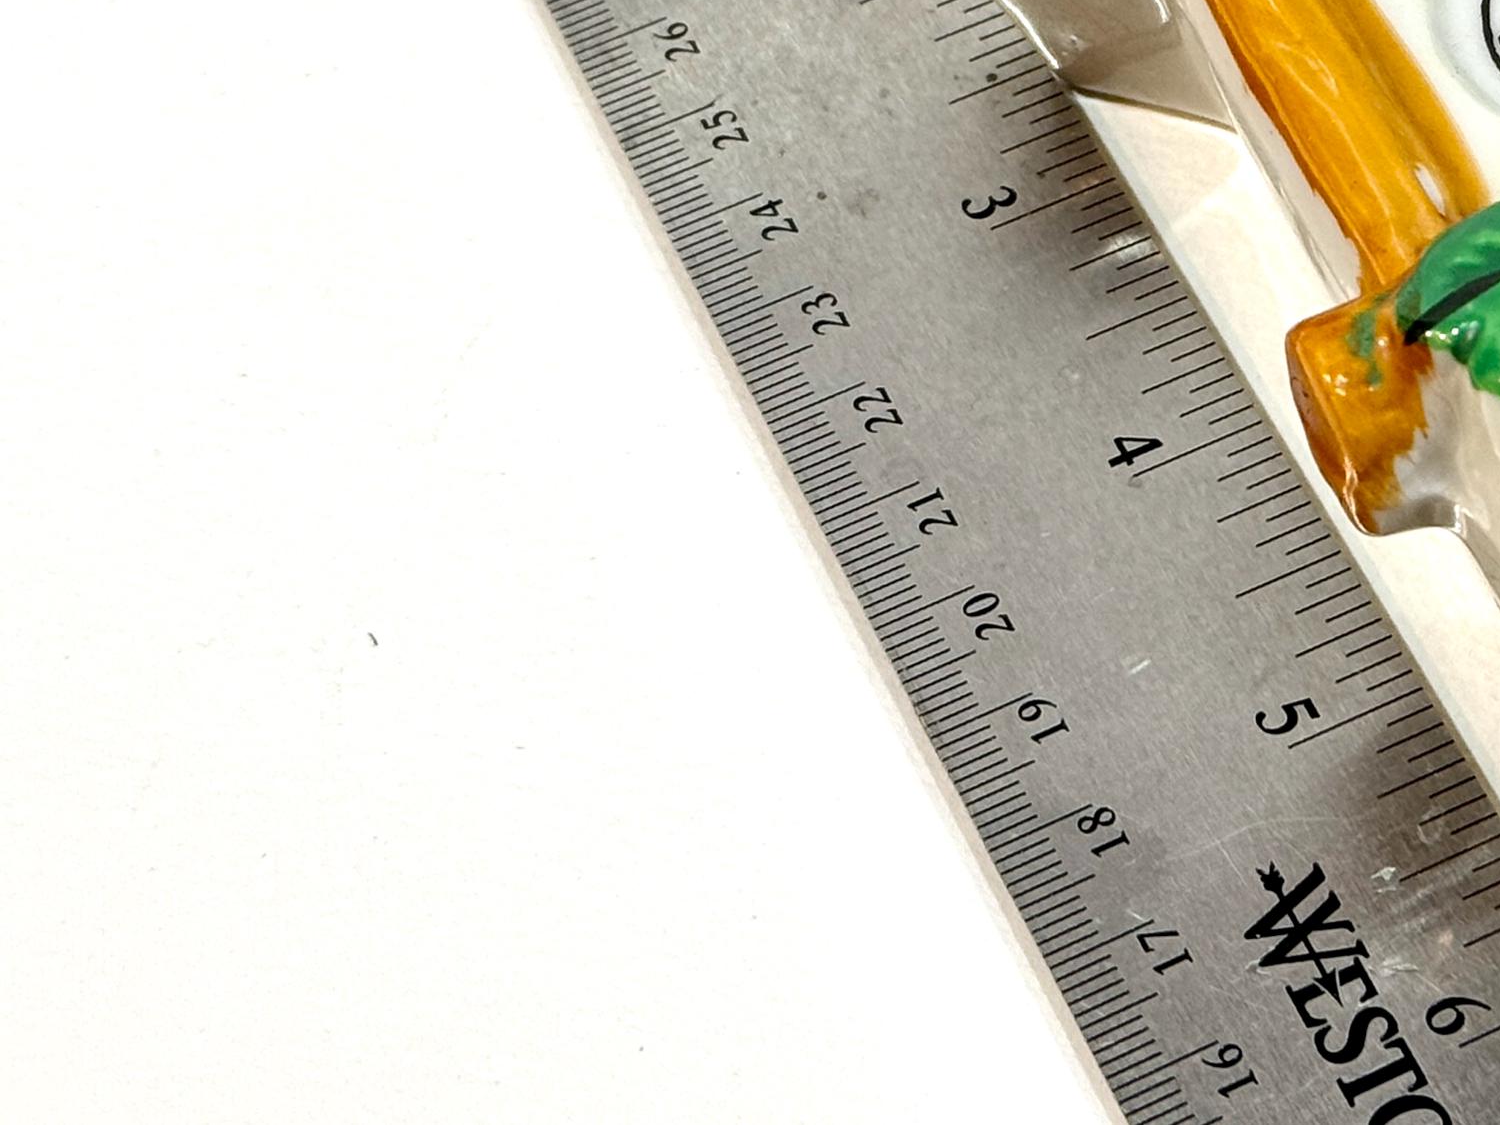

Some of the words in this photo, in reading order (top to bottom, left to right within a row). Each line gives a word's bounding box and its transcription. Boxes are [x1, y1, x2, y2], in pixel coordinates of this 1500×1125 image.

[652, 21, 700, 63] 26
[700, 110, 750, 150] 25
[748, 198, 799, 242] 24
[961, 186, 1018, 220] 3
[801, 292, 850, 336] 23
[852, 387, 904, 434] 22
[1107, 435, 1164, 468] 4
[907, 487, 959, 535] 21
[962, 592, 1016, 641] 20
[1017, 697, 1070, 745] 19
[1254, 697, 1320, 735] 5
[1077, 806, 1131, 858] 18
[1136, 928, 1194, 976] 17
[1425, 997, 1492, 1036] 6
[1201, 1042, 1259, 1098] 16
